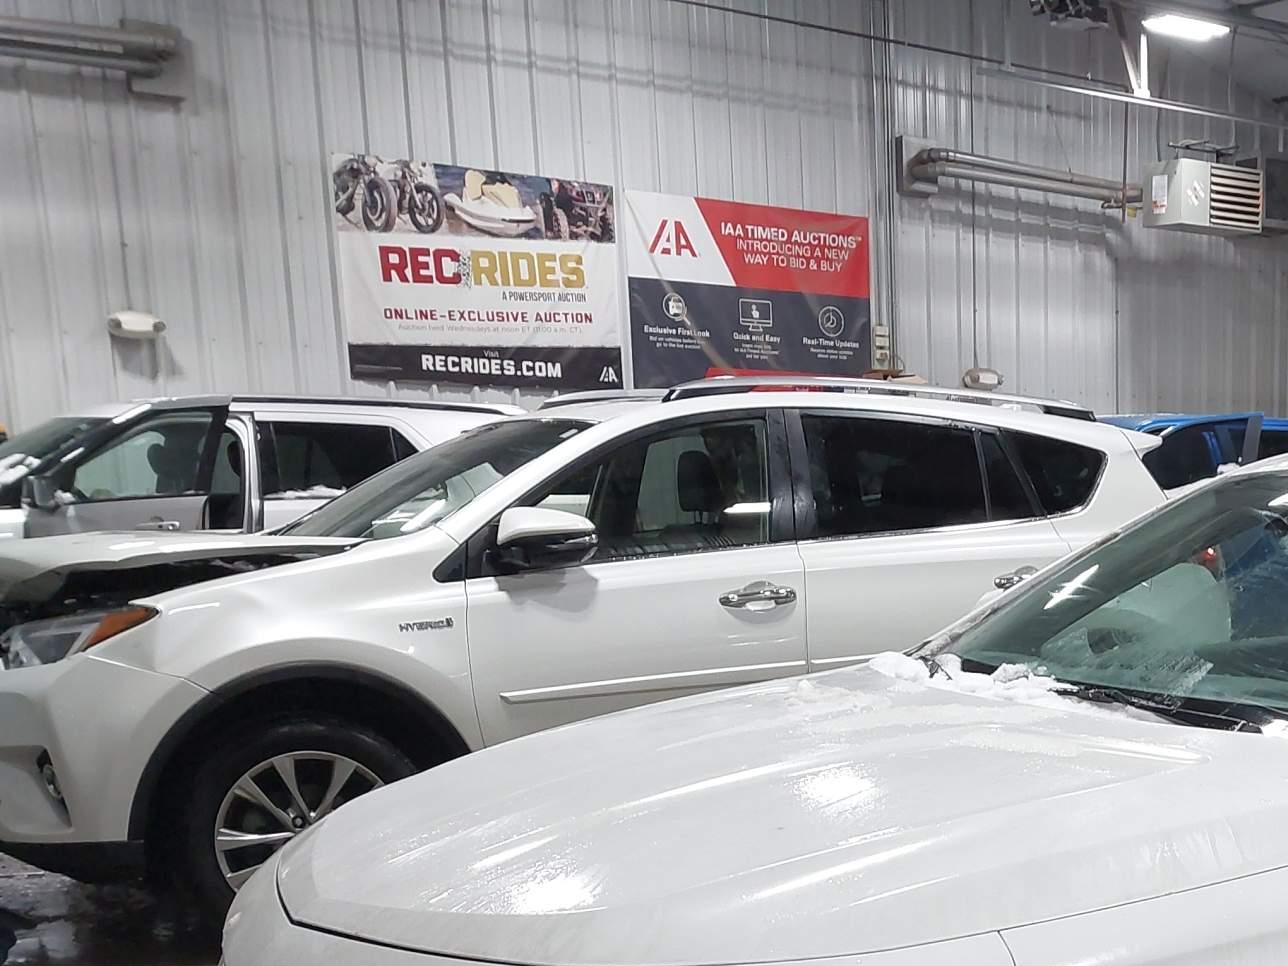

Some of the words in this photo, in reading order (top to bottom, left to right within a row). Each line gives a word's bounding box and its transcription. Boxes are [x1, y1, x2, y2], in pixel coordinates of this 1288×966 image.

[721, 222, 744, 237] IAA
[746, 225, 788, 241] TIMED
[736, 239, 811, 257] INTRODUCING
[813, 247, 822, 257] A
[824, 248, 849, 260] NEW
[378, 245, 462, 285] REC
[470, 249, 586, 289] RIDES
[743, 253, 770, 266] WAY
[771, 255, 787, 267] TO
[790, 257, 807, 269] BID
[809, 259, 818, 270] &
[820, 260, 843, 273] BUY
[502, 291, 509, 301] A
[509, 292, 556, 303] POWERSPORT
[557, 293, 587, 303] AUCTION
[384, 308, 529, 323] ONLINE-EXCLUSIVE
[534, 312, 593, 324] AUCTION
[644, 325, 677, 335] Exclusive
[678, 328, 693, 336] First
[733, 332, 750, 341] Quick
[752, 333, 764, 342] and
[765, 334, 781, 343] Easy
[802, 337, 834, 347] Real-Time
[835, 339, 859, 349] Updates
[421, 354, 562, 378] RECRIDES.COM
